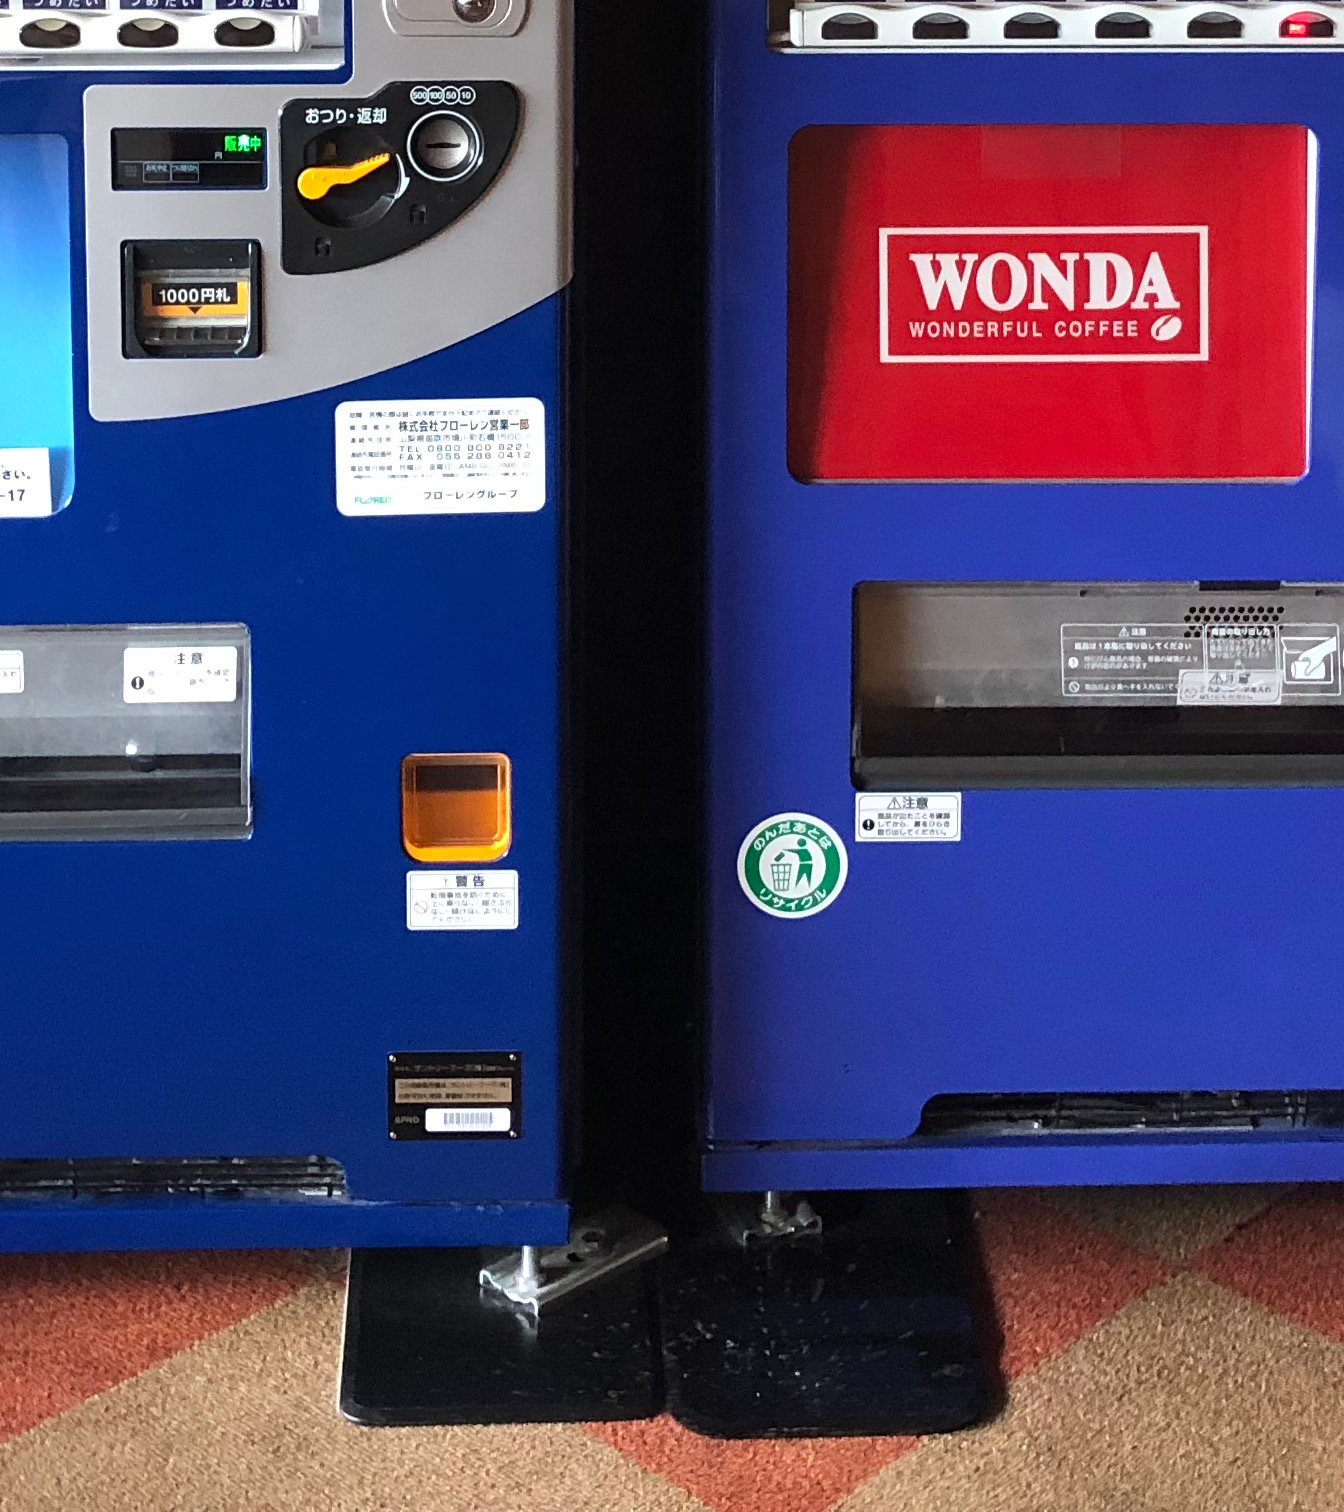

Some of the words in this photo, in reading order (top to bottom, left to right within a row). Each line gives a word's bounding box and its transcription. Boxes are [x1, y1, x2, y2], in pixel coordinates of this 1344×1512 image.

[413, 90, 428, 100] 500
[429, 90, 444, 100] 100
[445, 90, 457, 100] 50
[460, 90, 472, 100] 10
[305, 107, 388, 125] おつり・返却
[224, 135, 262, 154] 販売中
[909, 251, 1181, 312] WONDA
[158, 287, 231, 304] 1000円札
[909, 320, 1043, 339] WONDERFUL
[1054, 319, 1140, 338] COFFEE
[423, 489, 518, 501] フローレングループ
[902, 797, 929, 810] 注意
[753, 822, 833, 852] のんだあとは
[759, 887, 828, 911] リサイクル
